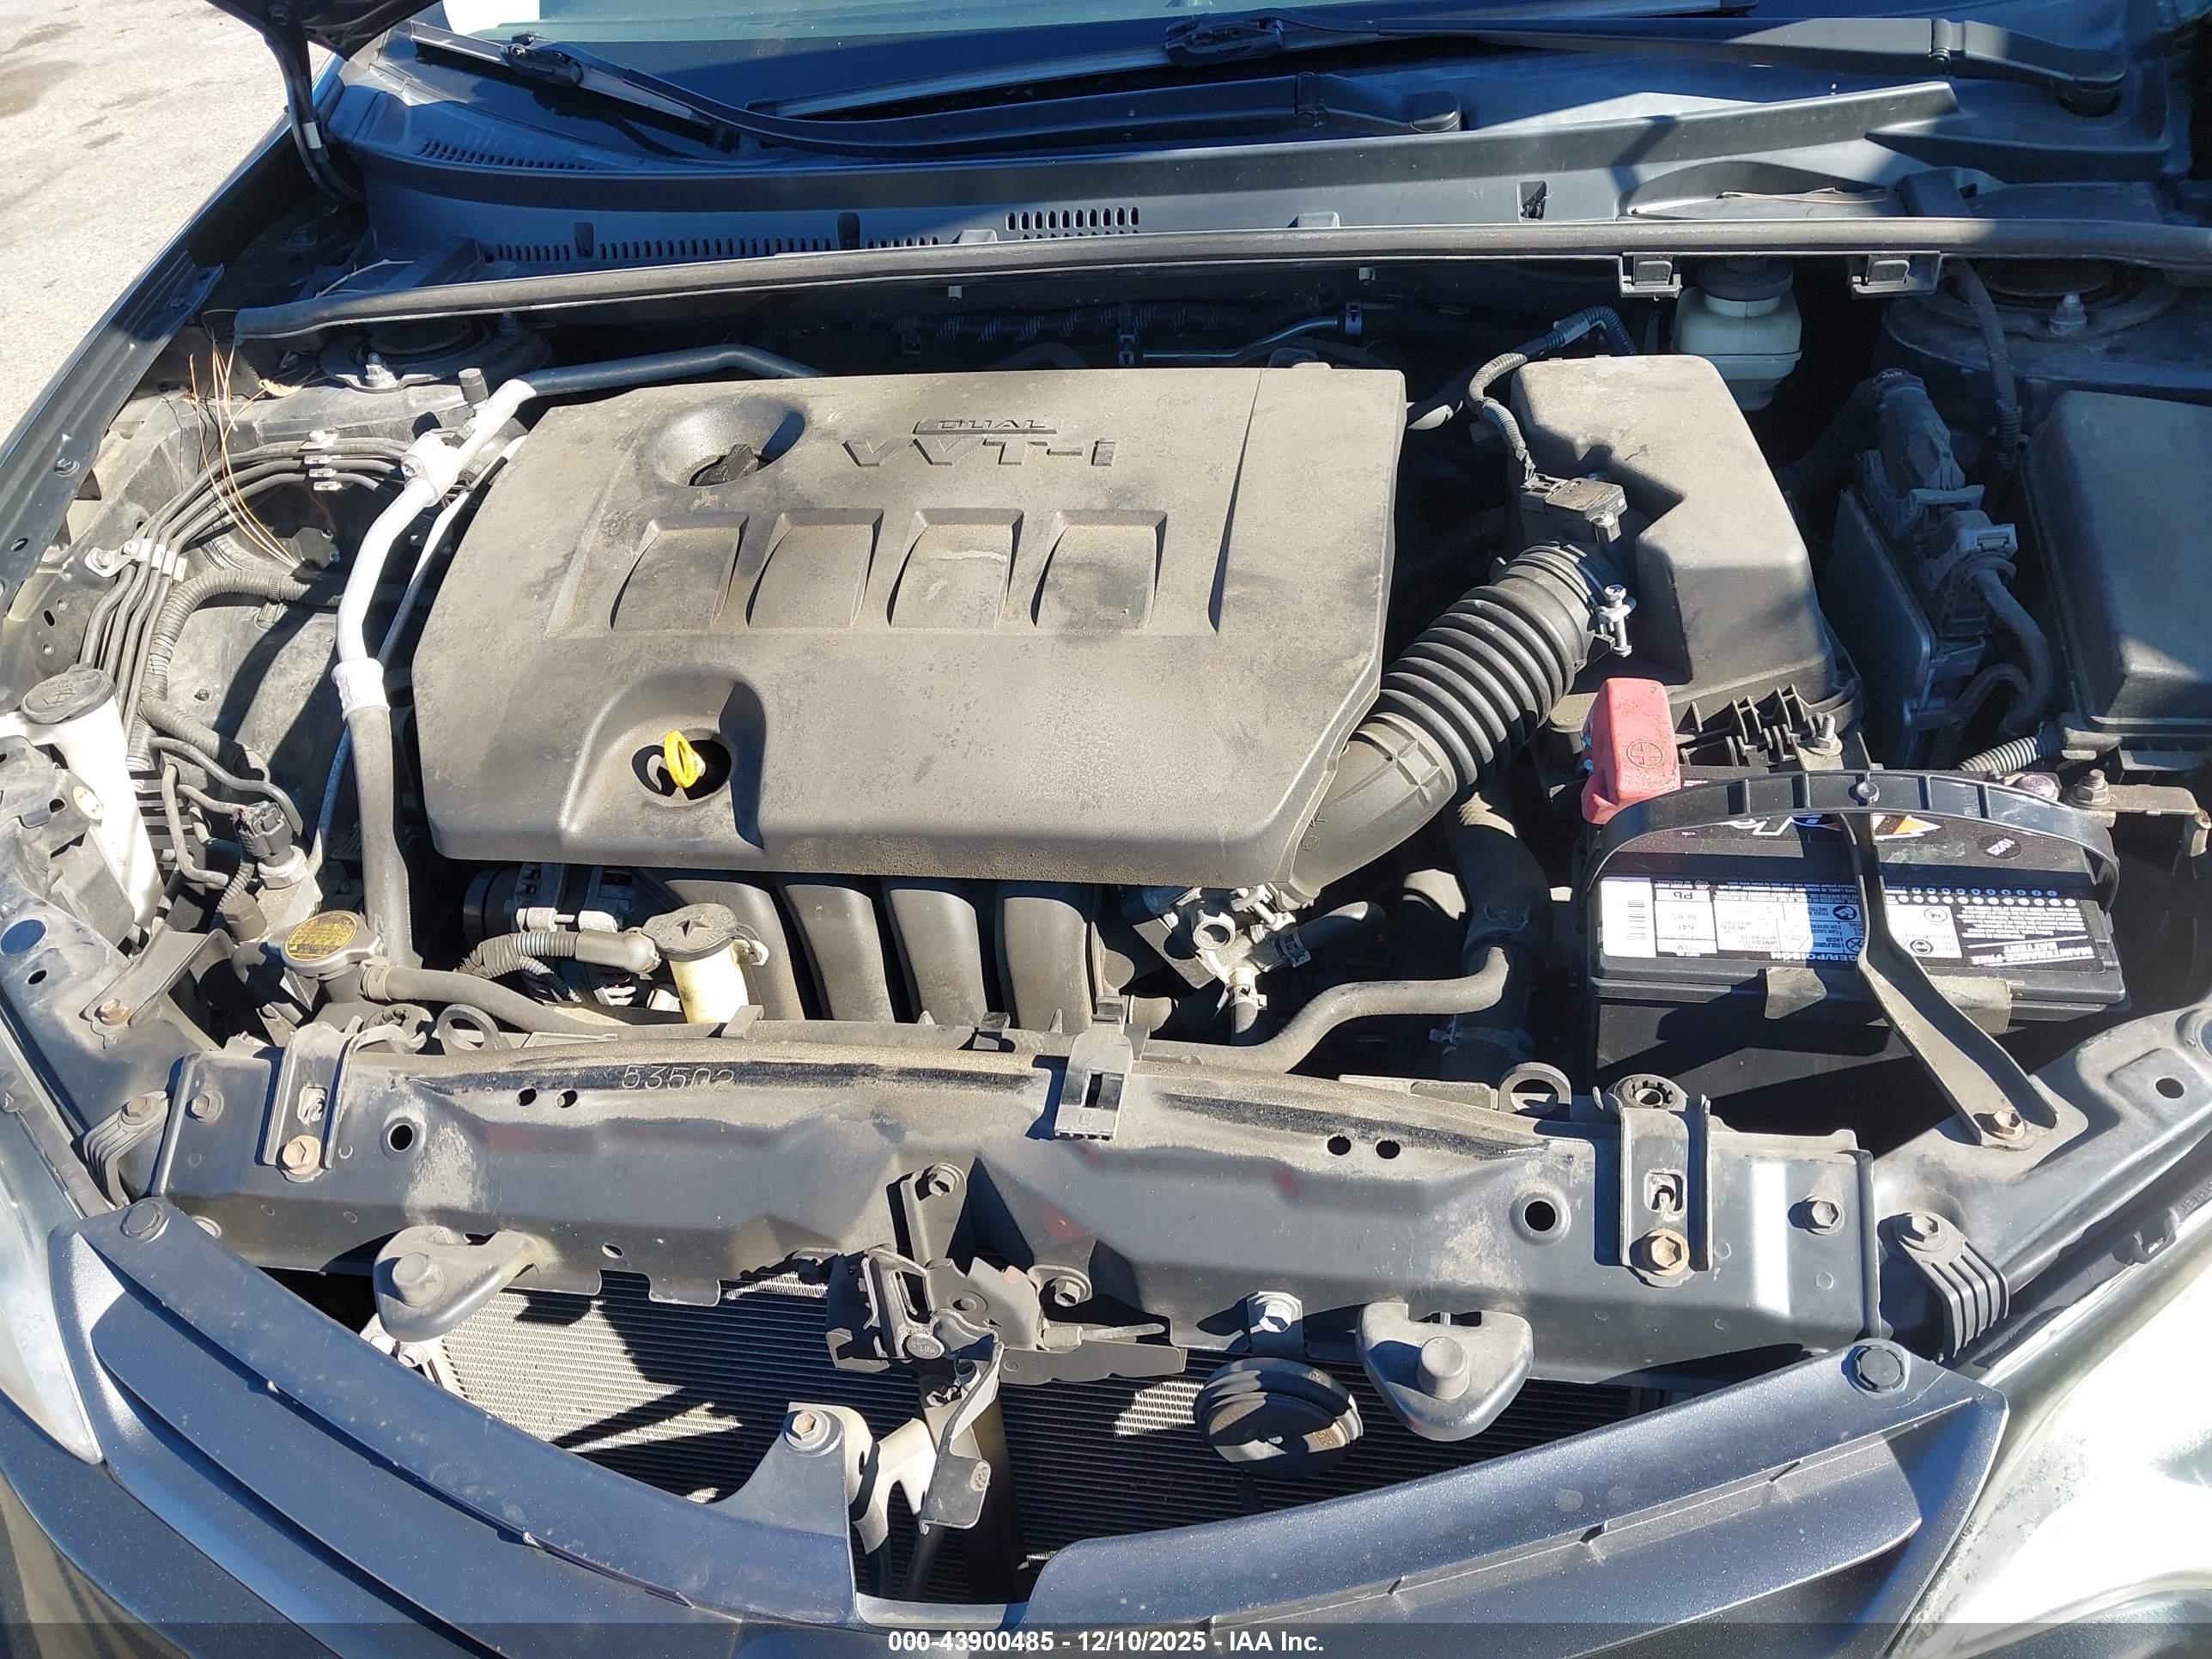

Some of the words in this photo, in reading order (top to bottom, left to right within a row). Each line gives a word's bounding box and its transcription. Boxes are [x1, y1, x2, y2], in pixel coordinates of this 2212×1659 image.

[938, 419, 1046, 428] DUAL
[1986, 838, 2015, 856] 10/25
[1674, 891, 1692, 901] Pb
[1771, 952, 1857, 962] GER/POISON
[622, 1065, 736, 1093] 53502
